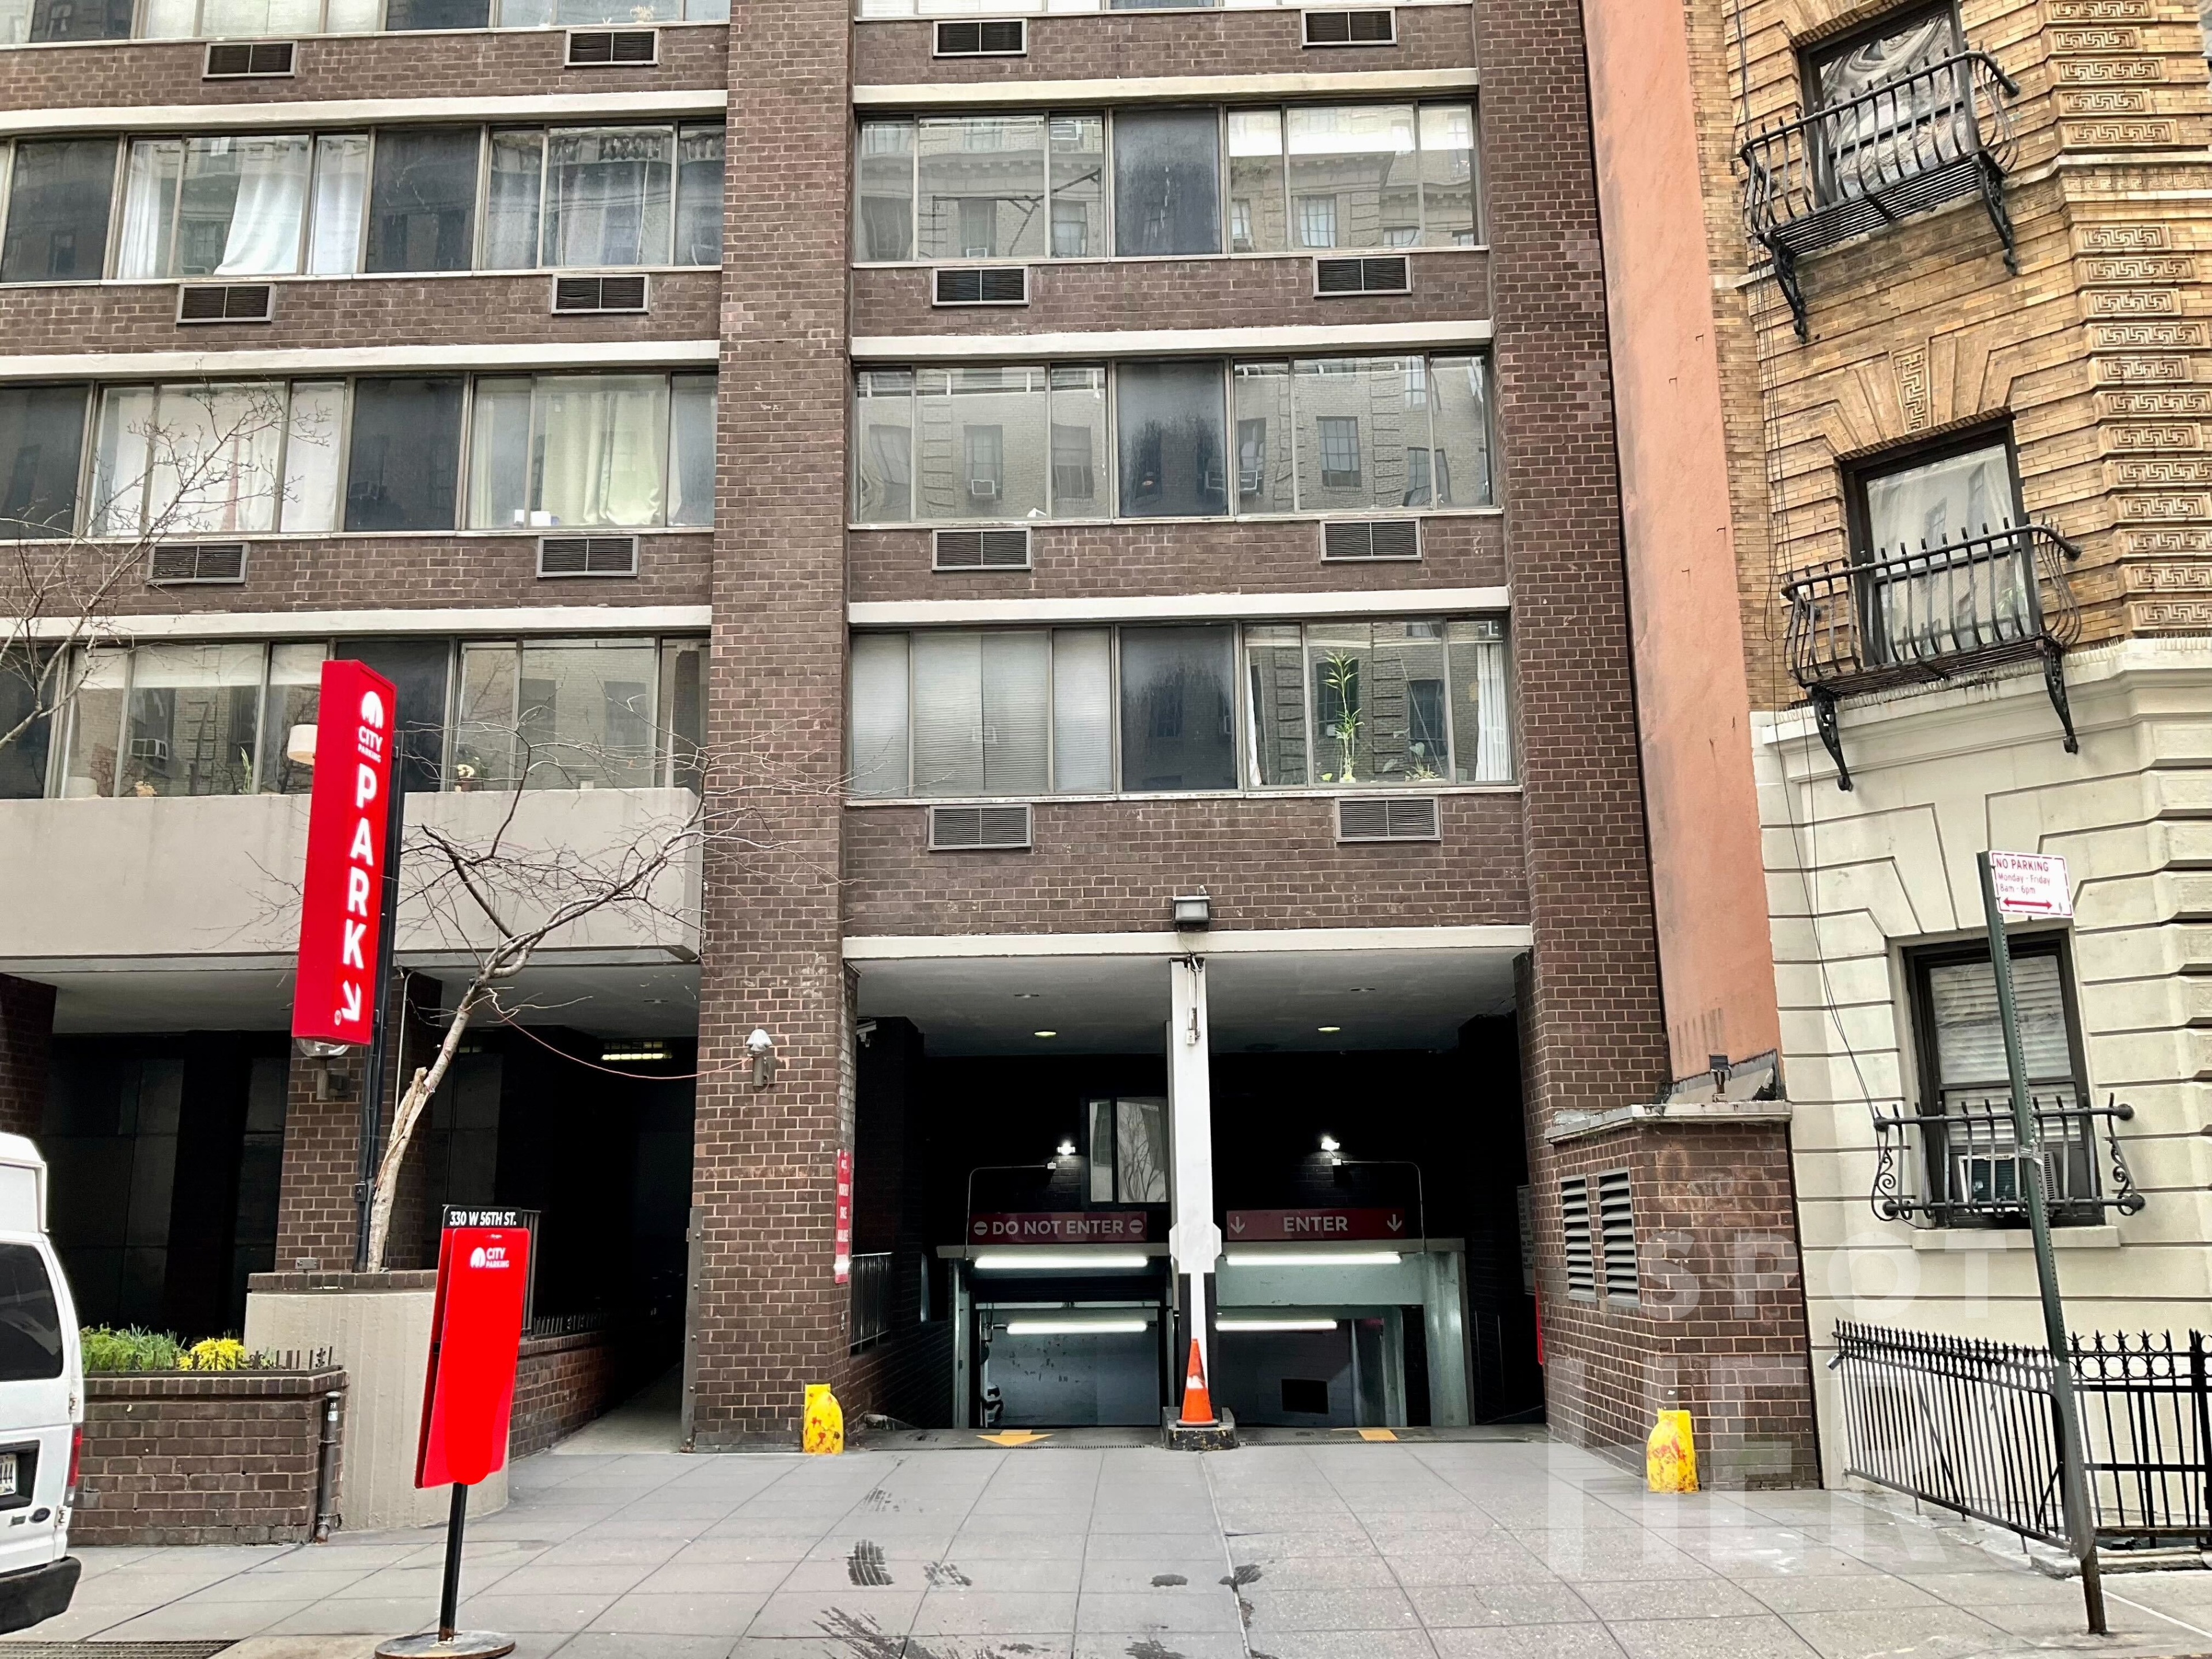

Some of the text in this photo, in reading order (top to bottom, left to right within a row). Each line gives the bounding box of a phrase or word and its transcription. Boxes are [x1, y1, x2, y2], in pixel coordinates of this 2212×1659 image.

[358, 725, 383, 752] CITY
[357, 743, 382, 763] PARKING
[343, 763, 377, 969] PARK
[1996, 858, 2050, 872] NO PARKING
[1998, 873, 2024, 884] Monday
[2030, 874, 2050, 886] Friday
[2000, 883, 2014, 893] 8am
[2021, 885, 2036, 895] 6pm
[449, 1211, 517, 1226] 330 W 56TH ST.
[1283, 1216, 1348, 1232] ENTER
[993, 1220, 1124, 1235] DO NOT ENTER
[486, 1247, 505, 1260] CITY
[486, 1260, 509, 1268] PARKING
